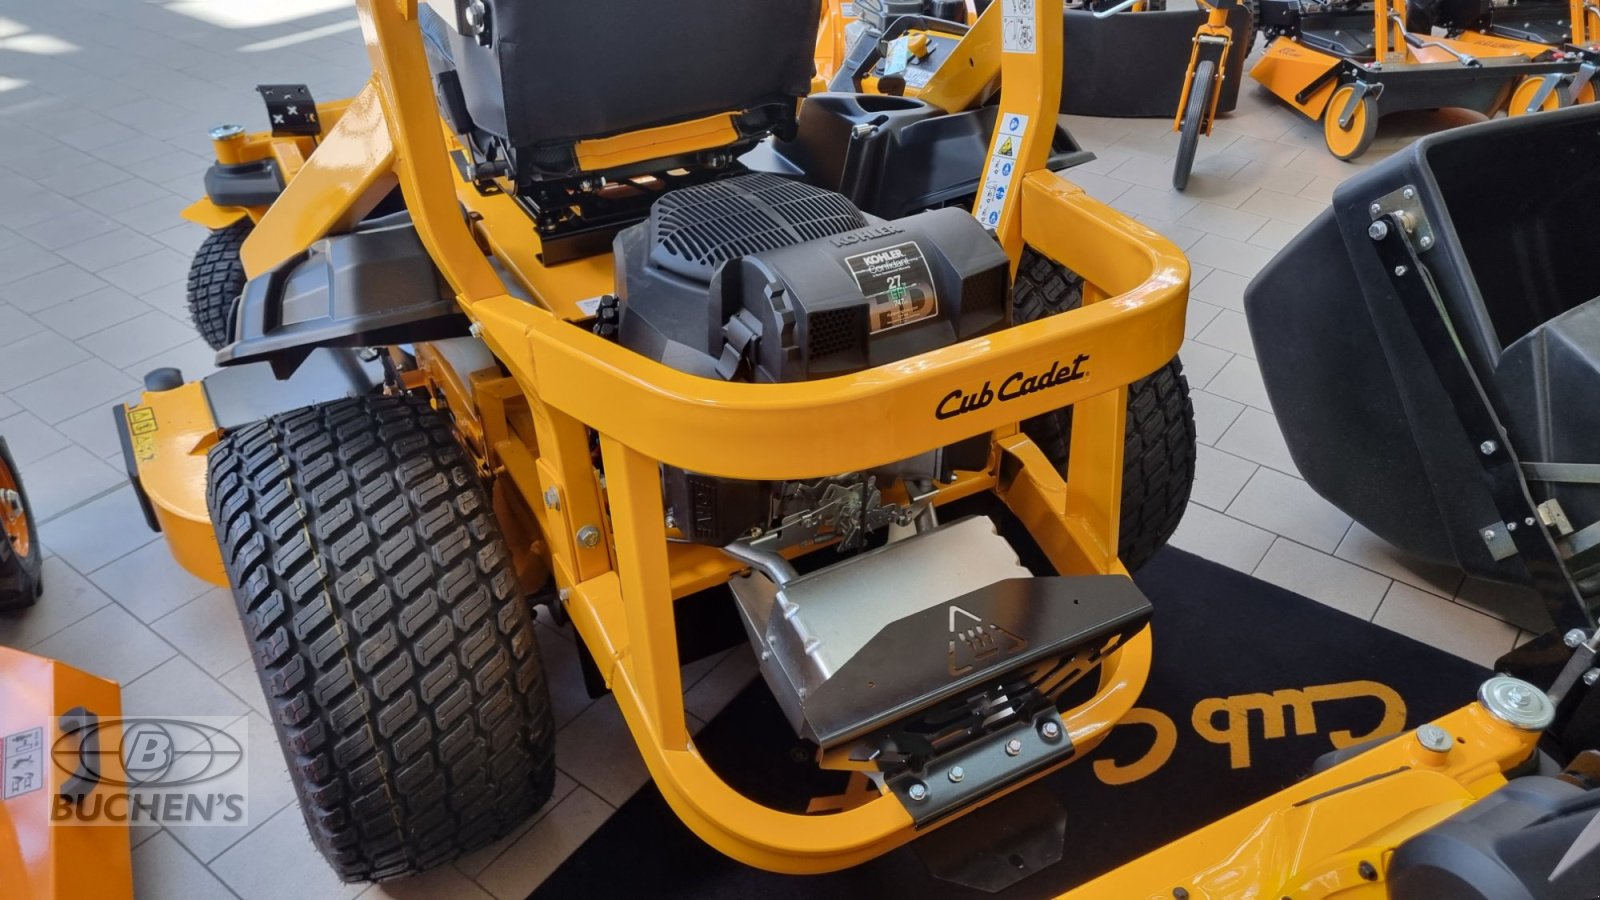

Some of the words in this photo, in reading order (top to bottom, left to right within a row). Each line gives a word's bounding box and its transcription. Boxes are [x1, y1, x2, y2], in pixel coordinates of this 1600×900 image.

[830, 225, 904, 247] KOHLER
[863, 249, 905, 266] KOHLER
[886, 274, 901, 290] 27
[935, 381, 994, 420] Cub
[997, 354, 1090, 401] Cadet
[1191, 680, 1407, 769] Cub
